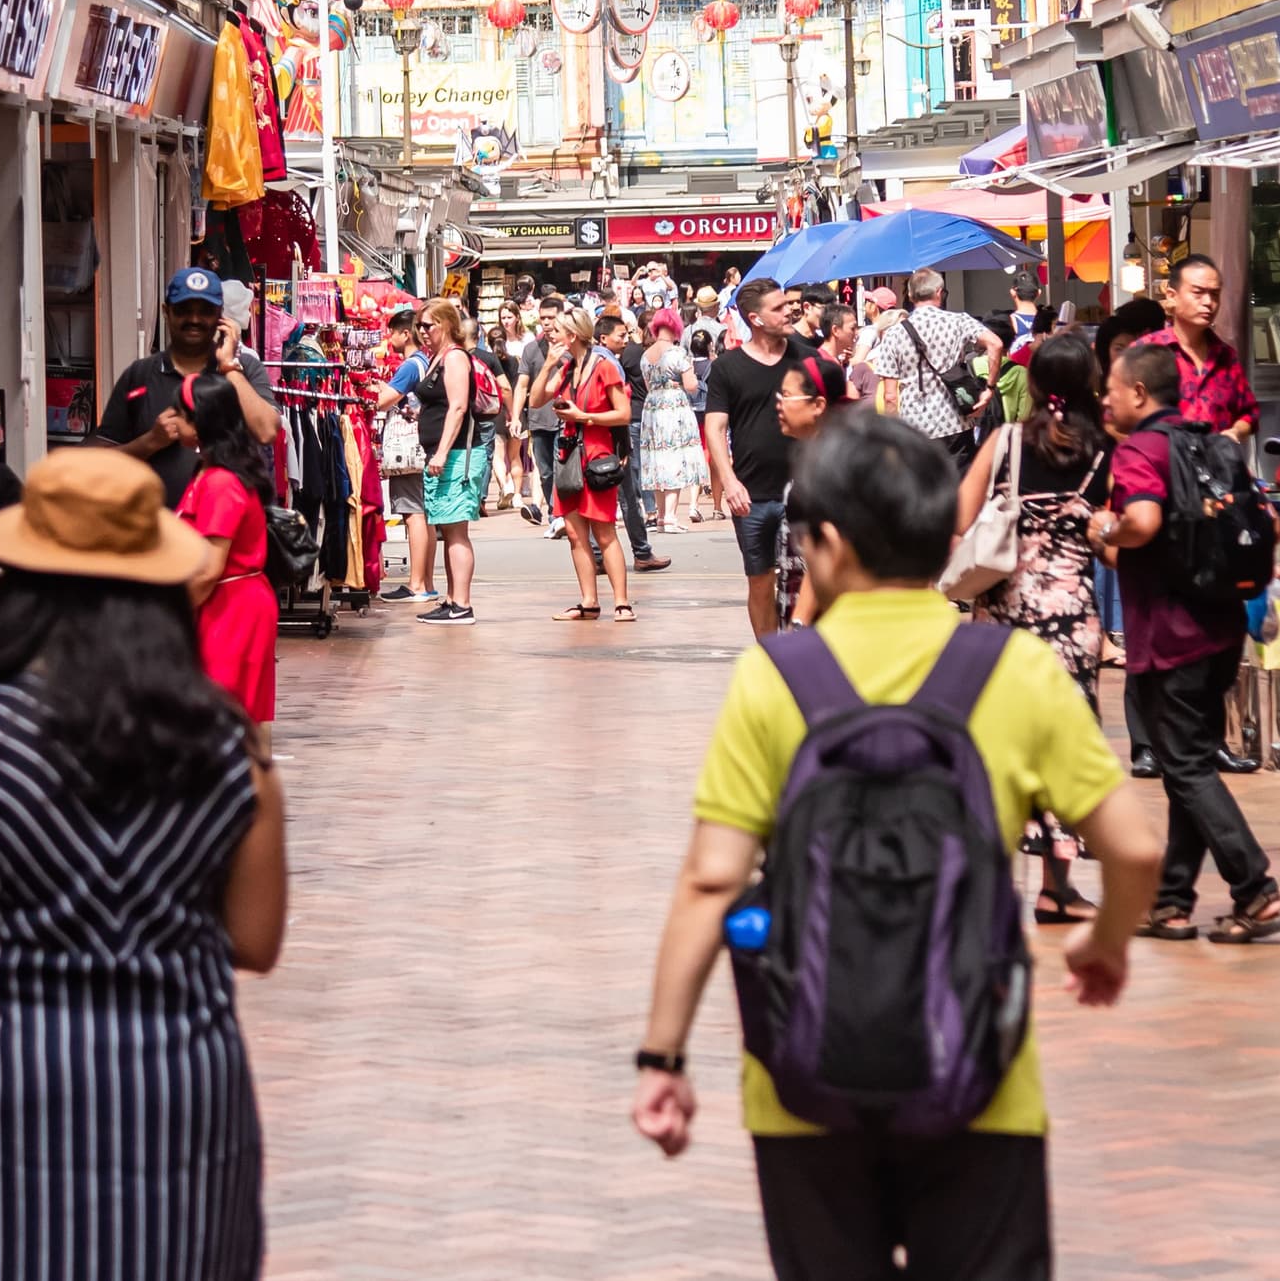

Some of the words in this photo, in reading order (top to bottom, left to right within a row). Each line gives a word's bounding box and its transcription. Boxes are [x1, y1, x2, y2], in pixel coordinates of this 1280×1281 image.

[113, 17, 142, 100] GIFT
[129, 25, 160, 106] SHOP
[434, 86, 514, 106] Changer
[520, 224, 570, 236] CHANGER
